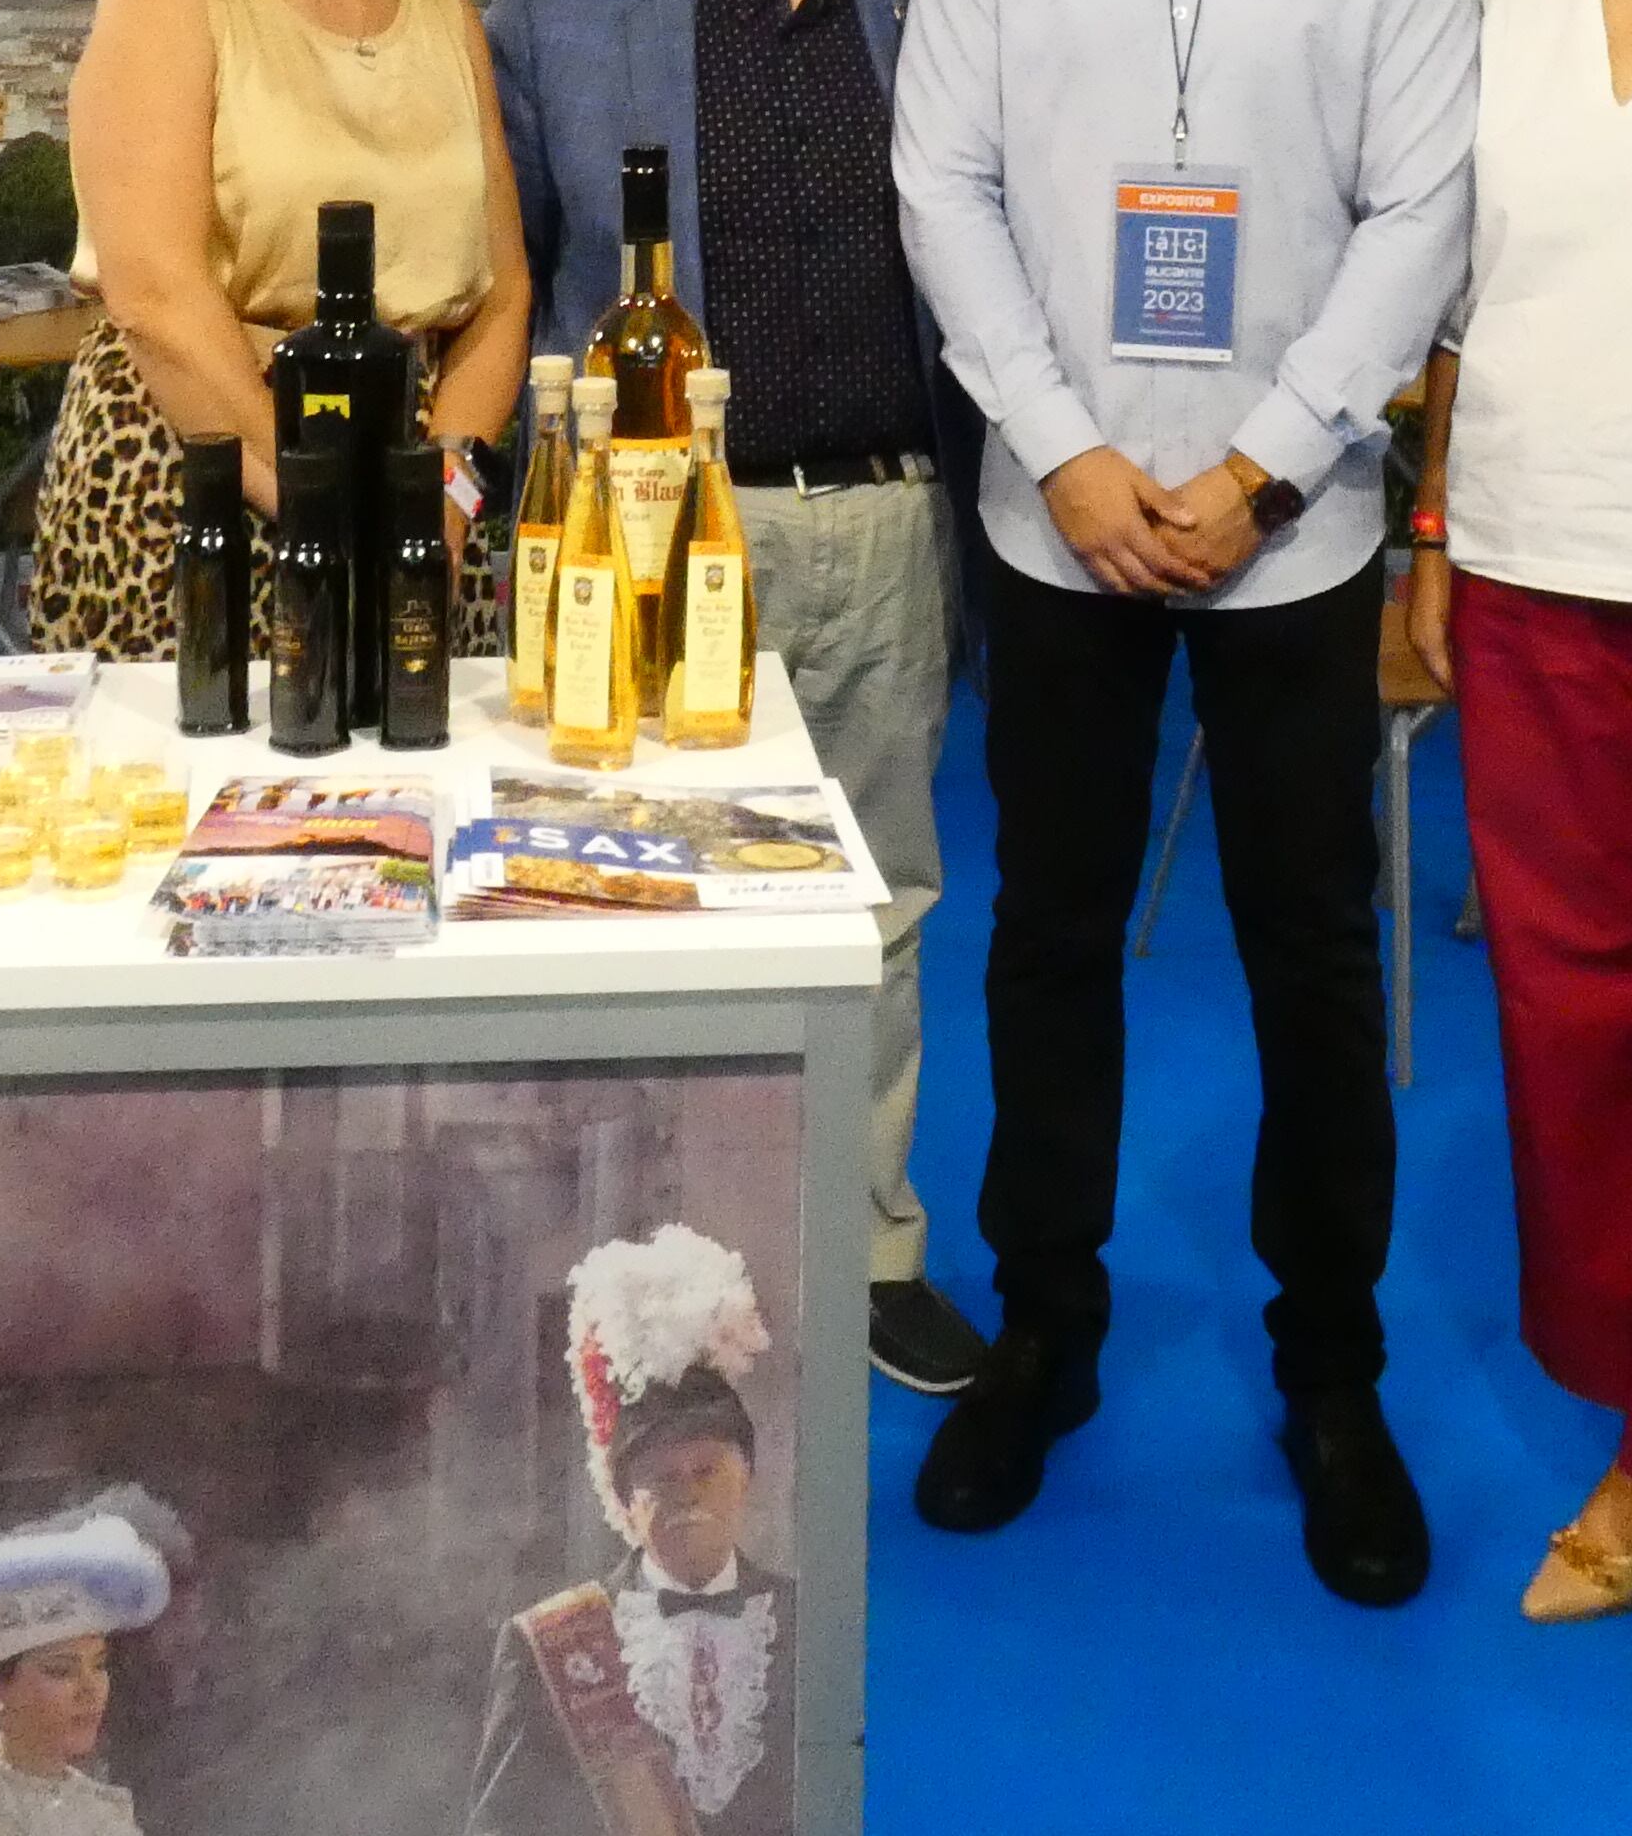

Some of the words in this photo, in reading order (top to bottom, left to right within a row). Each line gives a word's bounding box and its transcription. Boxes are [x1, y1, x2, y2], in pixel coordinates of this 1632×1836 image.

[1140, 193, 1216, 208] EXPOSITOR
[1144, 289, 1204, 313] 2023
[528, 826, 684, 865] SAX
